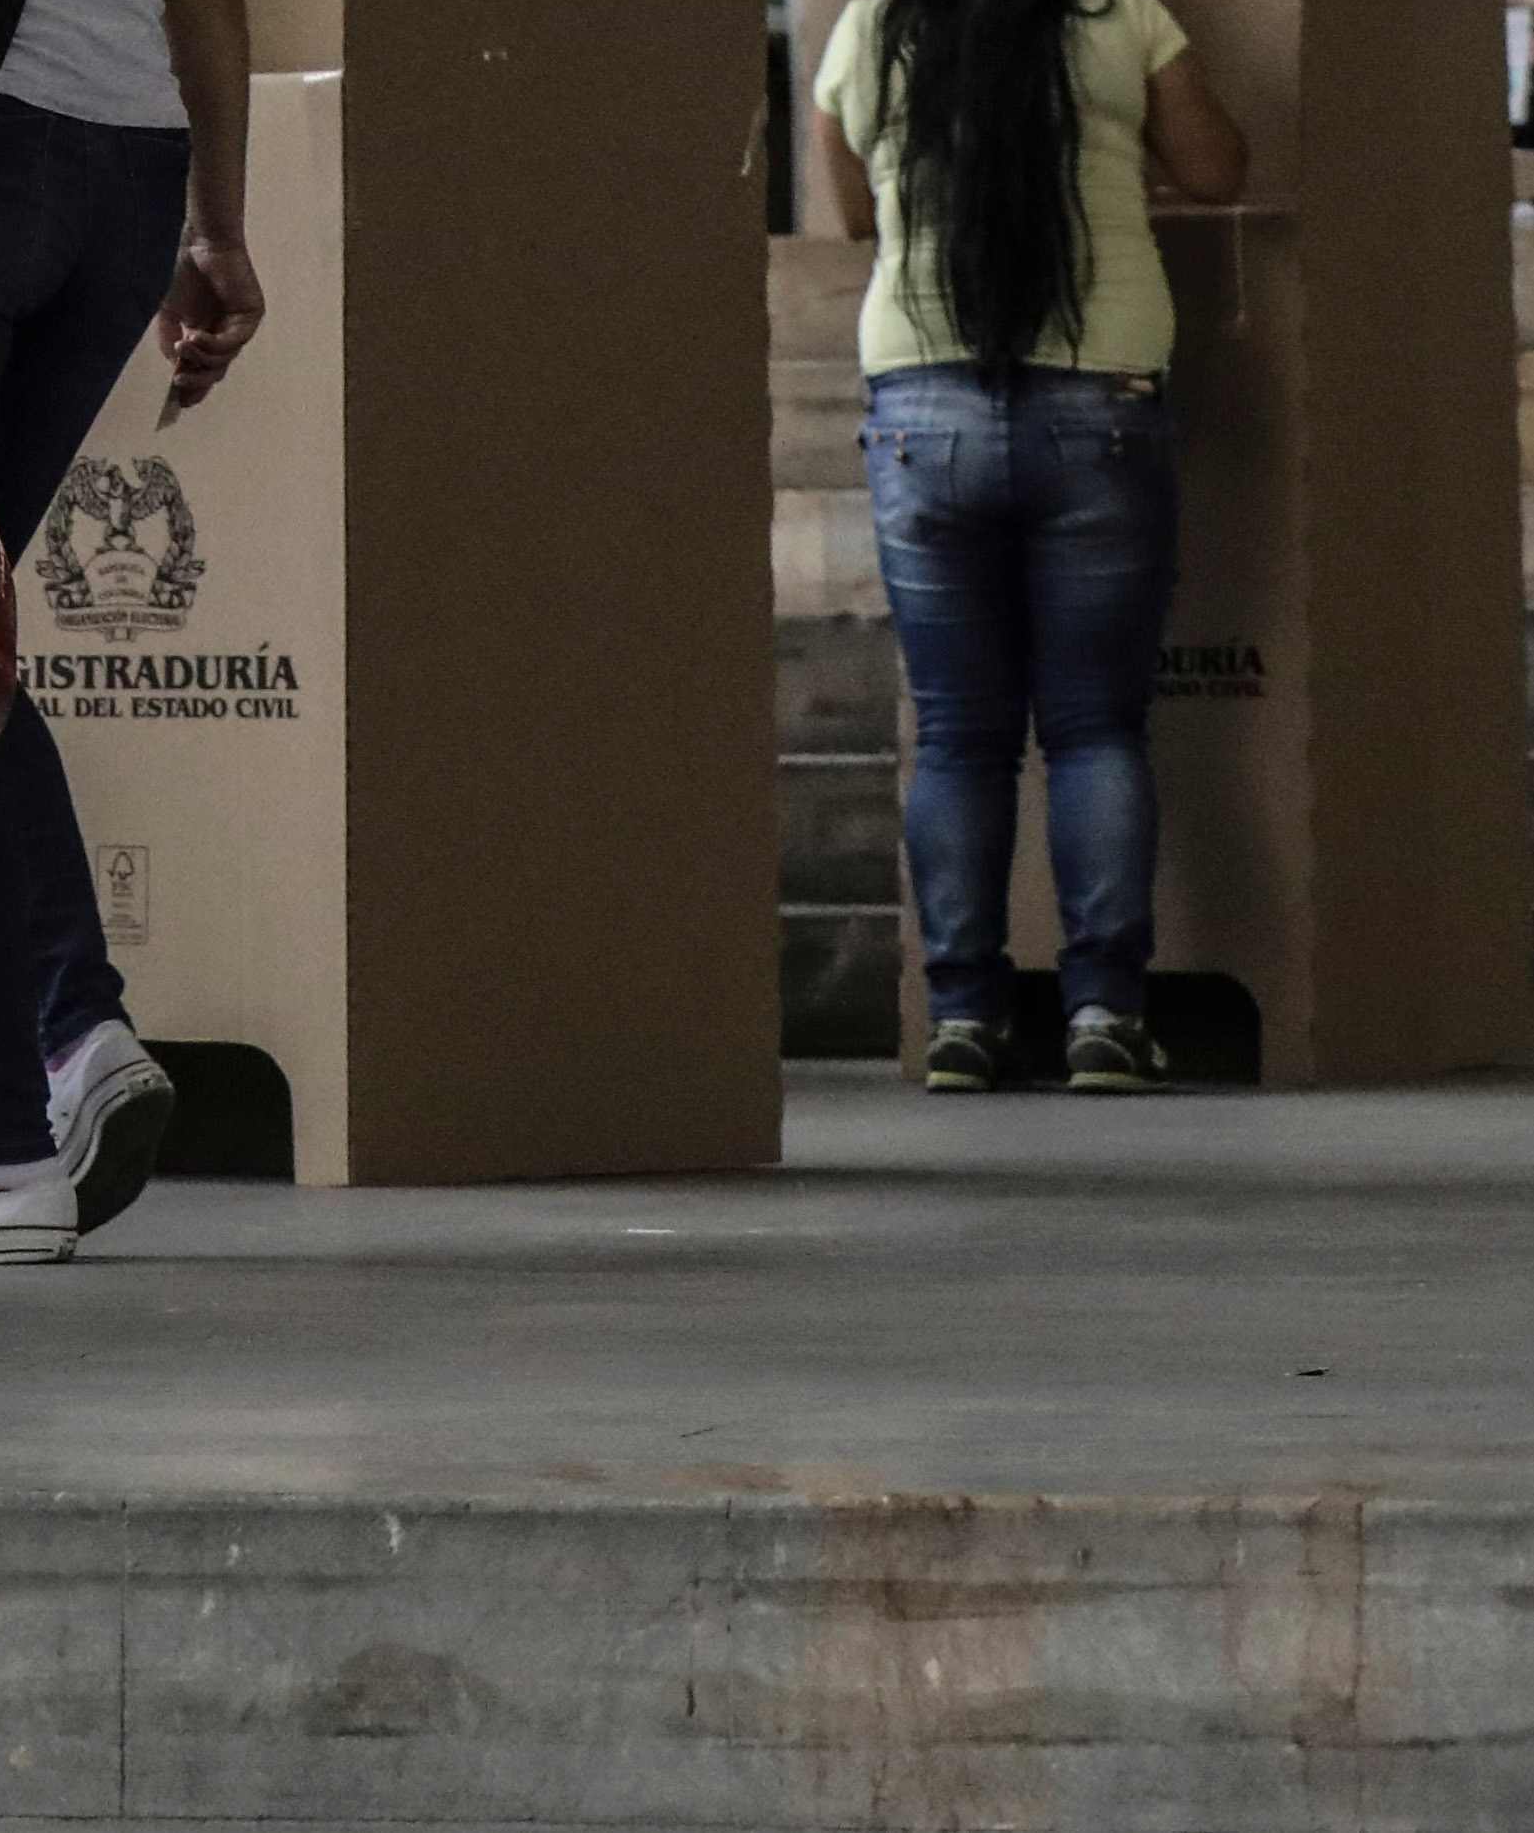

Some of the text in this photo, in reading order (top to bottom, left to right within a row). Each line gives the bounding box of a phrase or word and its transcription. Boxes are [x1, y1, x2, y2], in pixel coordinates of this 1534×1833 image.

[74, 696, 122, 719] DEL
[131, 696, 228, 719] ESTADO
[235, 696, 299, 719] CIVIL
